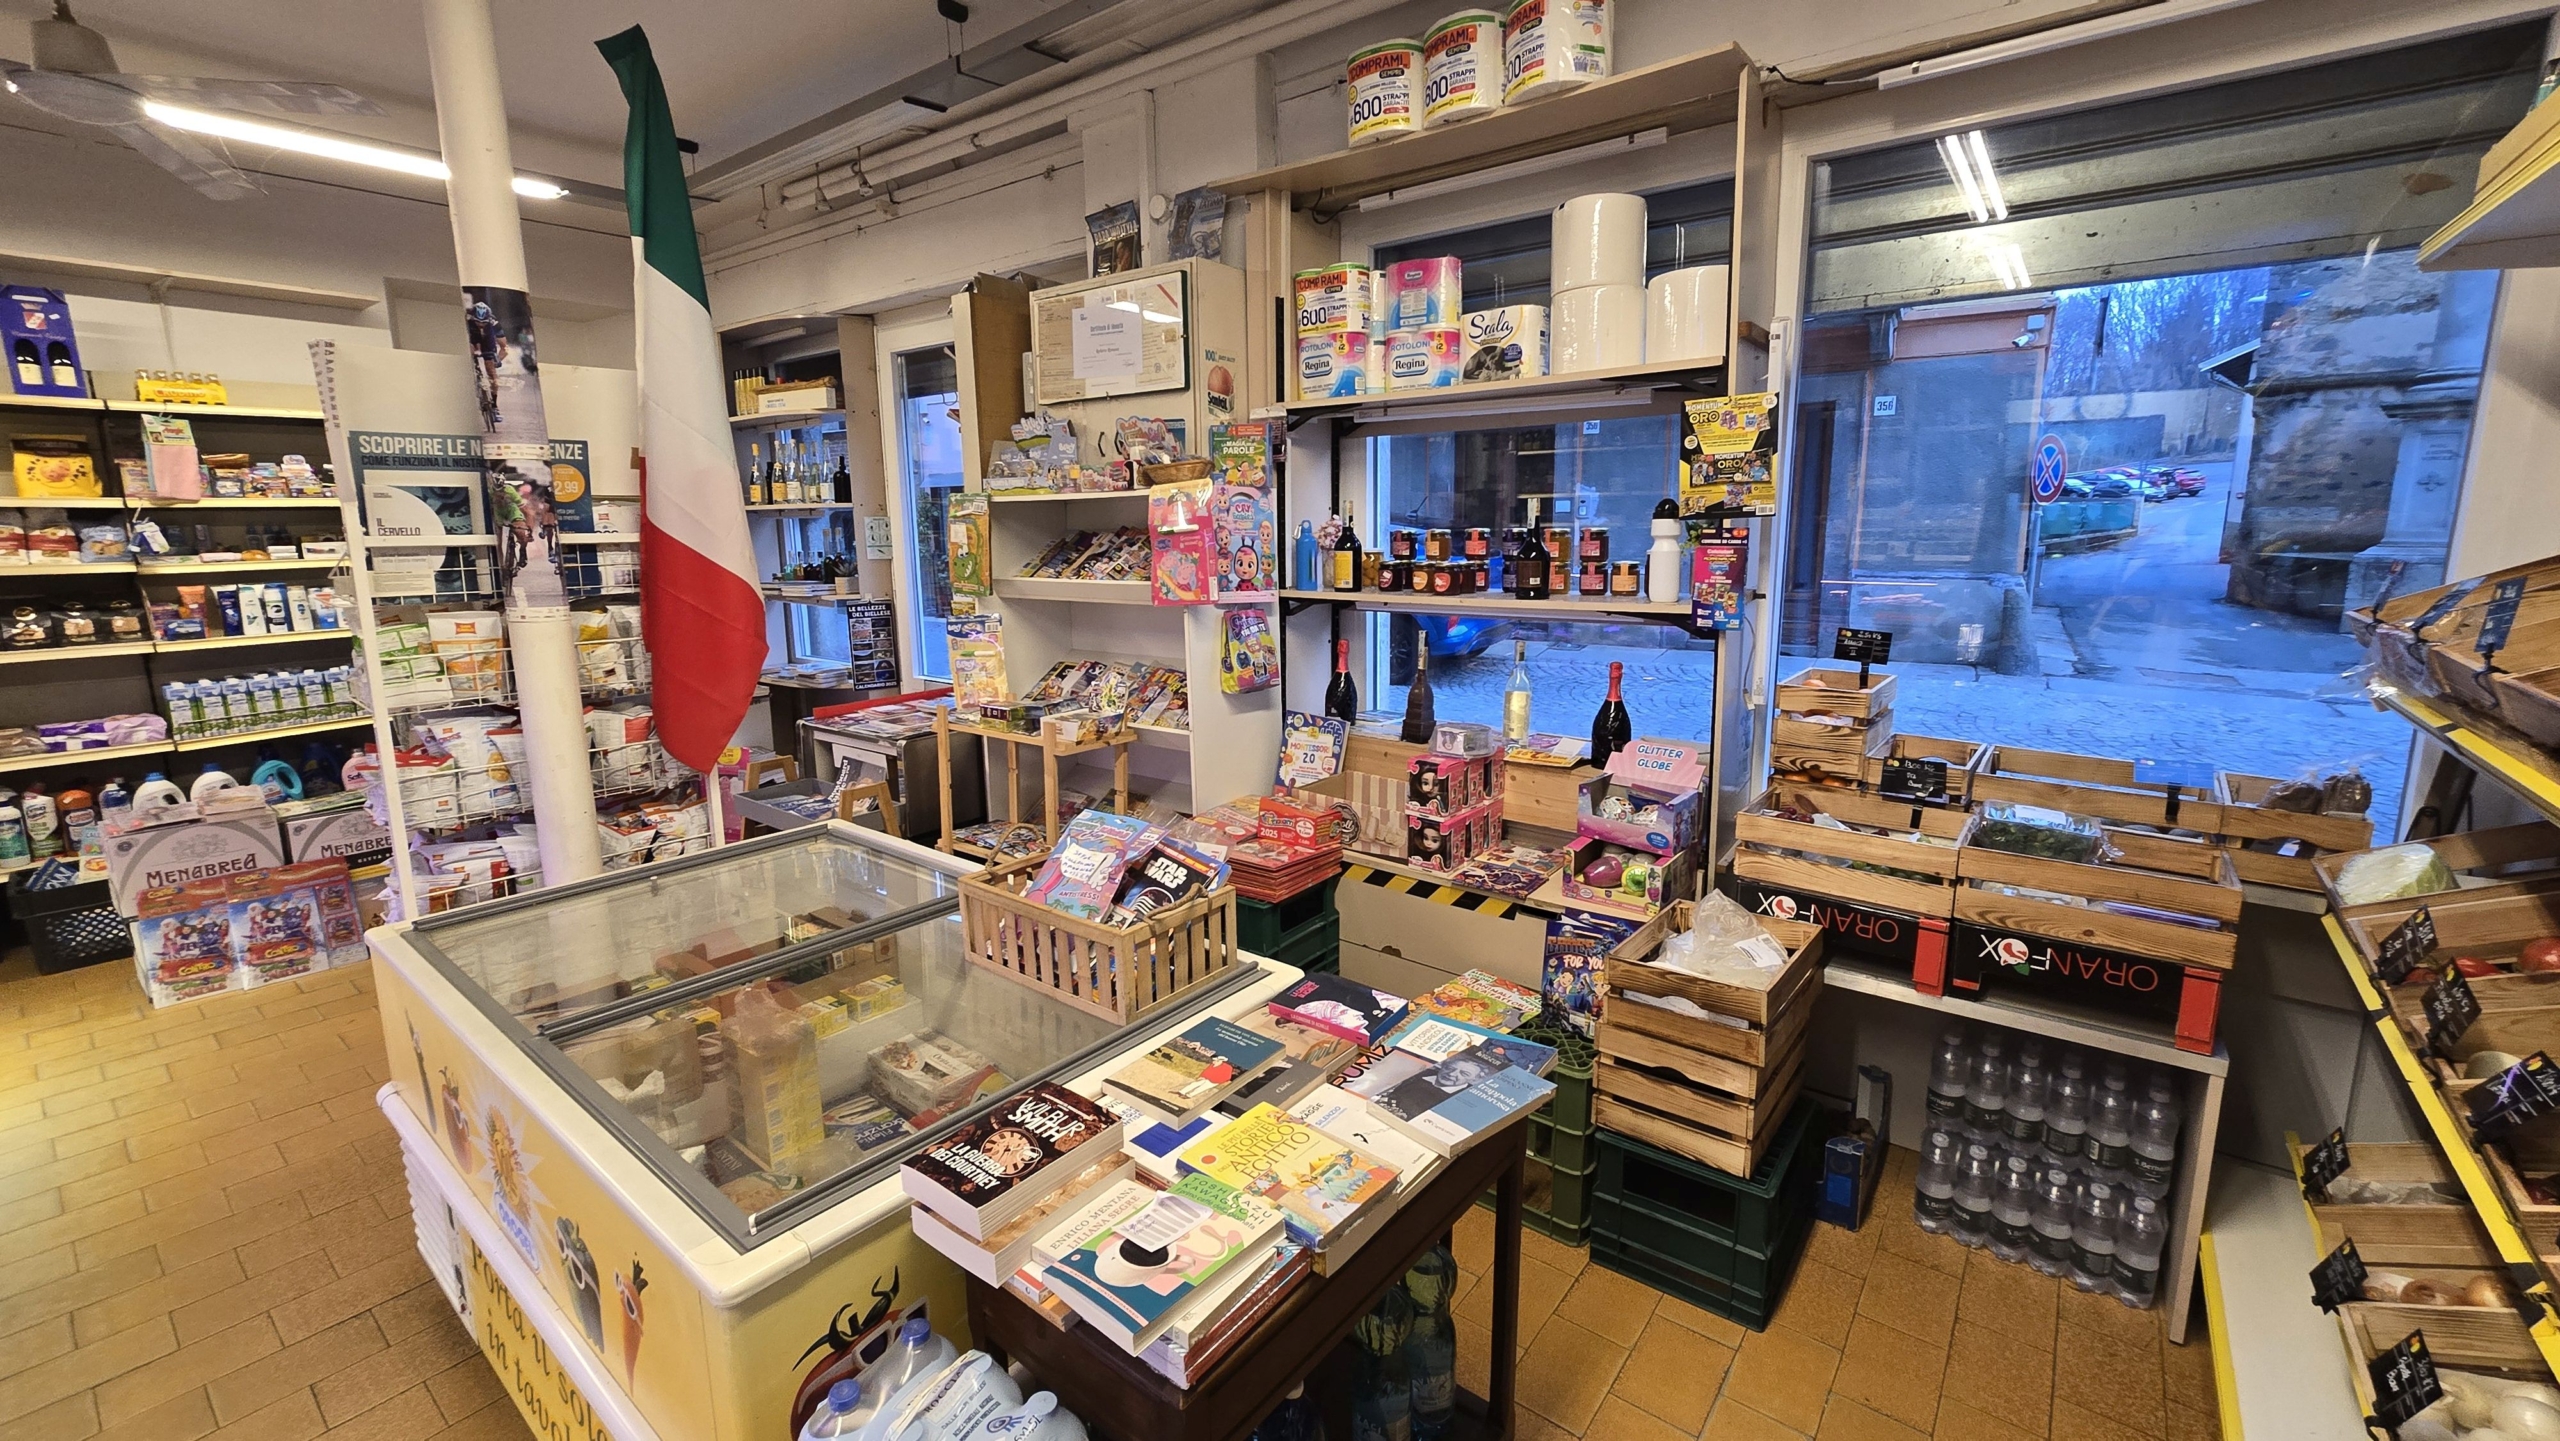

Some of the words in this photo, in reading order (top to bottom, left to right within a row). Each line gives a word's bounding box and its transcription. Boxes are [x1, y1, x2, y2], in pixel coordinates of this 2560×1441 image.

[1449, 68, 1476, 80] STRAPPI
[1468, 310, 1514, 342] Scala
[1300, 341, 1334, 353] ROTOLONI
[1390, 340, 1431, 352] ROTOLONI
[1304, 359, 1330, 371] Regina
[1395, 358, 1426, 370] Regina
[1689, 411, 1720, 424] ORO
[359, 435, 443, 456] SCOPRIRE
[447, 439, 467, 456] LE
[1222, 446, 1255, 455] PAROLE
[361, 455, 391, 466] COME
[392, 456, 440, 467] FUNZIONA
[442, 457, 451, 467] IL
[1717, 459, 1741, 468] ORO
[376, 517, 385, 528] IL
[378, 526, 421, 537] CERVELLO
[1289, 742, 1330, 754] MONTESSORI
[1302, 752, 1316, 764] 2.0
[1637, 745, 1684, 760] GLITTER
[1637, 758, 1673, 771] GLOBE
[1260, 827, 1279, 838] 2025
[146, 852, 257, 889] MENABREA
[1155, 856, 1188, 877] STAR
[1144, 868, 1185, 889] WARS
[1563, 954, 1584, 969] FOR
[1477, 981, 1513, 999] ANIMALI
[1490, 992, 1537, 1012] FATTORIA
[1407, 1024, 1438, 1047] VITTORINO
[1417, 1027, 1446, 1050] ANDREOLI
[1485, 1078, 1499, 1089] La
[1469, 1088, 1511, 1113] amorosa
[1478, 1083, 1519, 1109] trappola
[1007, 1106, 1064, 1143] SMITH
[1019, 1096, 1086, 1138] WILBUR
[1315, 1106, 1341, 1126] SILENZIO
[1216, 1140, 1229, 1151] LE
[1240, 1120, 1261, 1138] BELLE
[1225, 1122, 1273, 1157] STORIE
[1230, 1124, 1295, 1173] ANTICO
[1239, 1131, 1311, 1180] EGITTO
[930, 1147, 948, 1162] DEI
[944, 1153, 1001, 1190] COURTNEY
[951, 1142, 966, 1156] LA
[963, 1148, 1007, 1177] GUERRA
[1050, 1219, 1089, 1250] ENRICO
[1090, 1186, 1137, 1221] MENTANA
[1066, 1219, 1108, 1250] LILIANA
[1108, 1195, 1140, 1219] SEGRE
[472, 1248, 526, 1341] Porta
[532, 1329, 551, 1378] il
[486, 1313, 508, 1358] in
[923, 1370, 962, 1413] ROCCIA
